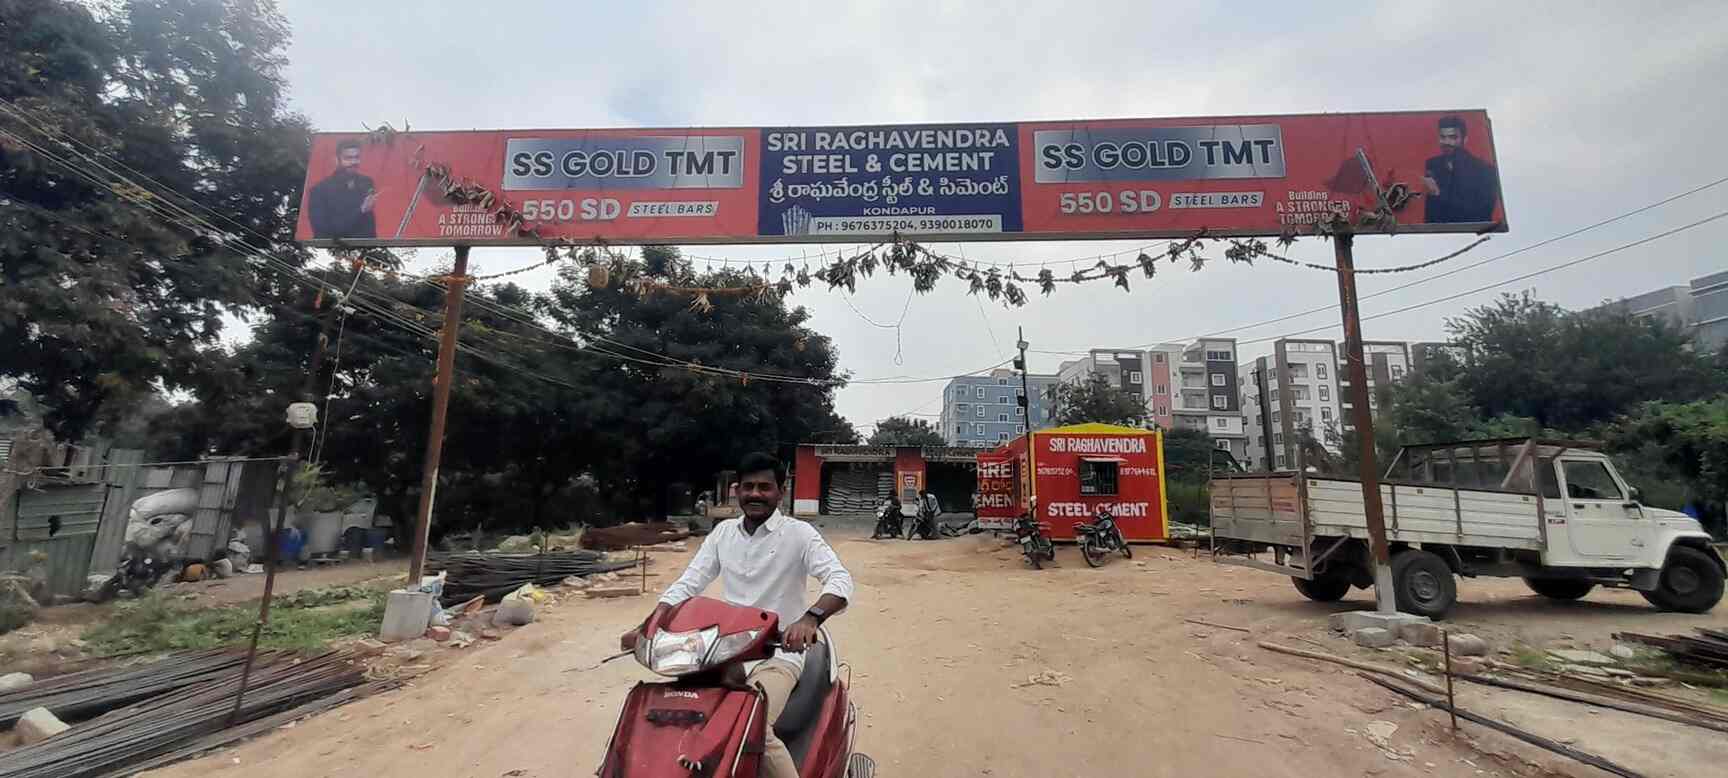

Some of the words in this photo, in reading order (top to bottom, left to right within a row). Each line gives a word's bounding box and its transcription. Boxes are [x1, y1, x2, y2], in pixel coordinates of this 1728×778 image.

[767, 133, 806, 151] SRI
[815, 129, 1010, 151] RAGHAVENDRA
[1042, 144, 1085, 169] SS
[1093, 141, 1192, 169] GOLD
[1199, 139, 1275, 165] TMT
[512, 151, 554, 178] SS
[561, 150, 657, 178] GOLD
[664, 150, 737, 176] TMT
[782, 154, 858, 174] STEEL
[865, 154, 882, 173] &
[889, 151, 994, 172] CEMENT
[769, 178, 785, 204] శ్రీ
[787, 177, 880, 202] రాఘవేంద్ర
[882, 175, 913, 204] స్టీల్
[918, 178, 934, 196] &
[939, 175, 1009, 196] సిమెంట్
[1288, 191, 1328, 200] Building
[1060, 192, 1113, 213] 550
[1119, 190, 1161, 213] SD
[1174, 195, 1215, 206] STEEL
[1221, 194, 1259, 205] BARS
[1276, 201, 1284, 212] A
[522, 200, 574, 221] 550
[580, 198, 621, 221] SD
[633, 204, 674, 215] STEEL
[677, 203, 713, 214] BARS
[863, 207, 936, 216] KONDAPUR
[439, 213, 446, 225] A
[450, 213, 497, 225] STRONG
[817, 221, 833, 231] PH
[841, 220, 917, 231] 9676375204,
[920, 219, 993, 230] 9390018070
[440, 224, 504, 237] TOMORROW
[1049, 438, 1066, 452] SRI
[1067, 438, 1147, 453] RAGHAVENDRA
[1048, 502, 1091, 516] STEEL
[1095, 502, 1149, 516] CEMENT
[664, 689, 699, 698] HONDA
